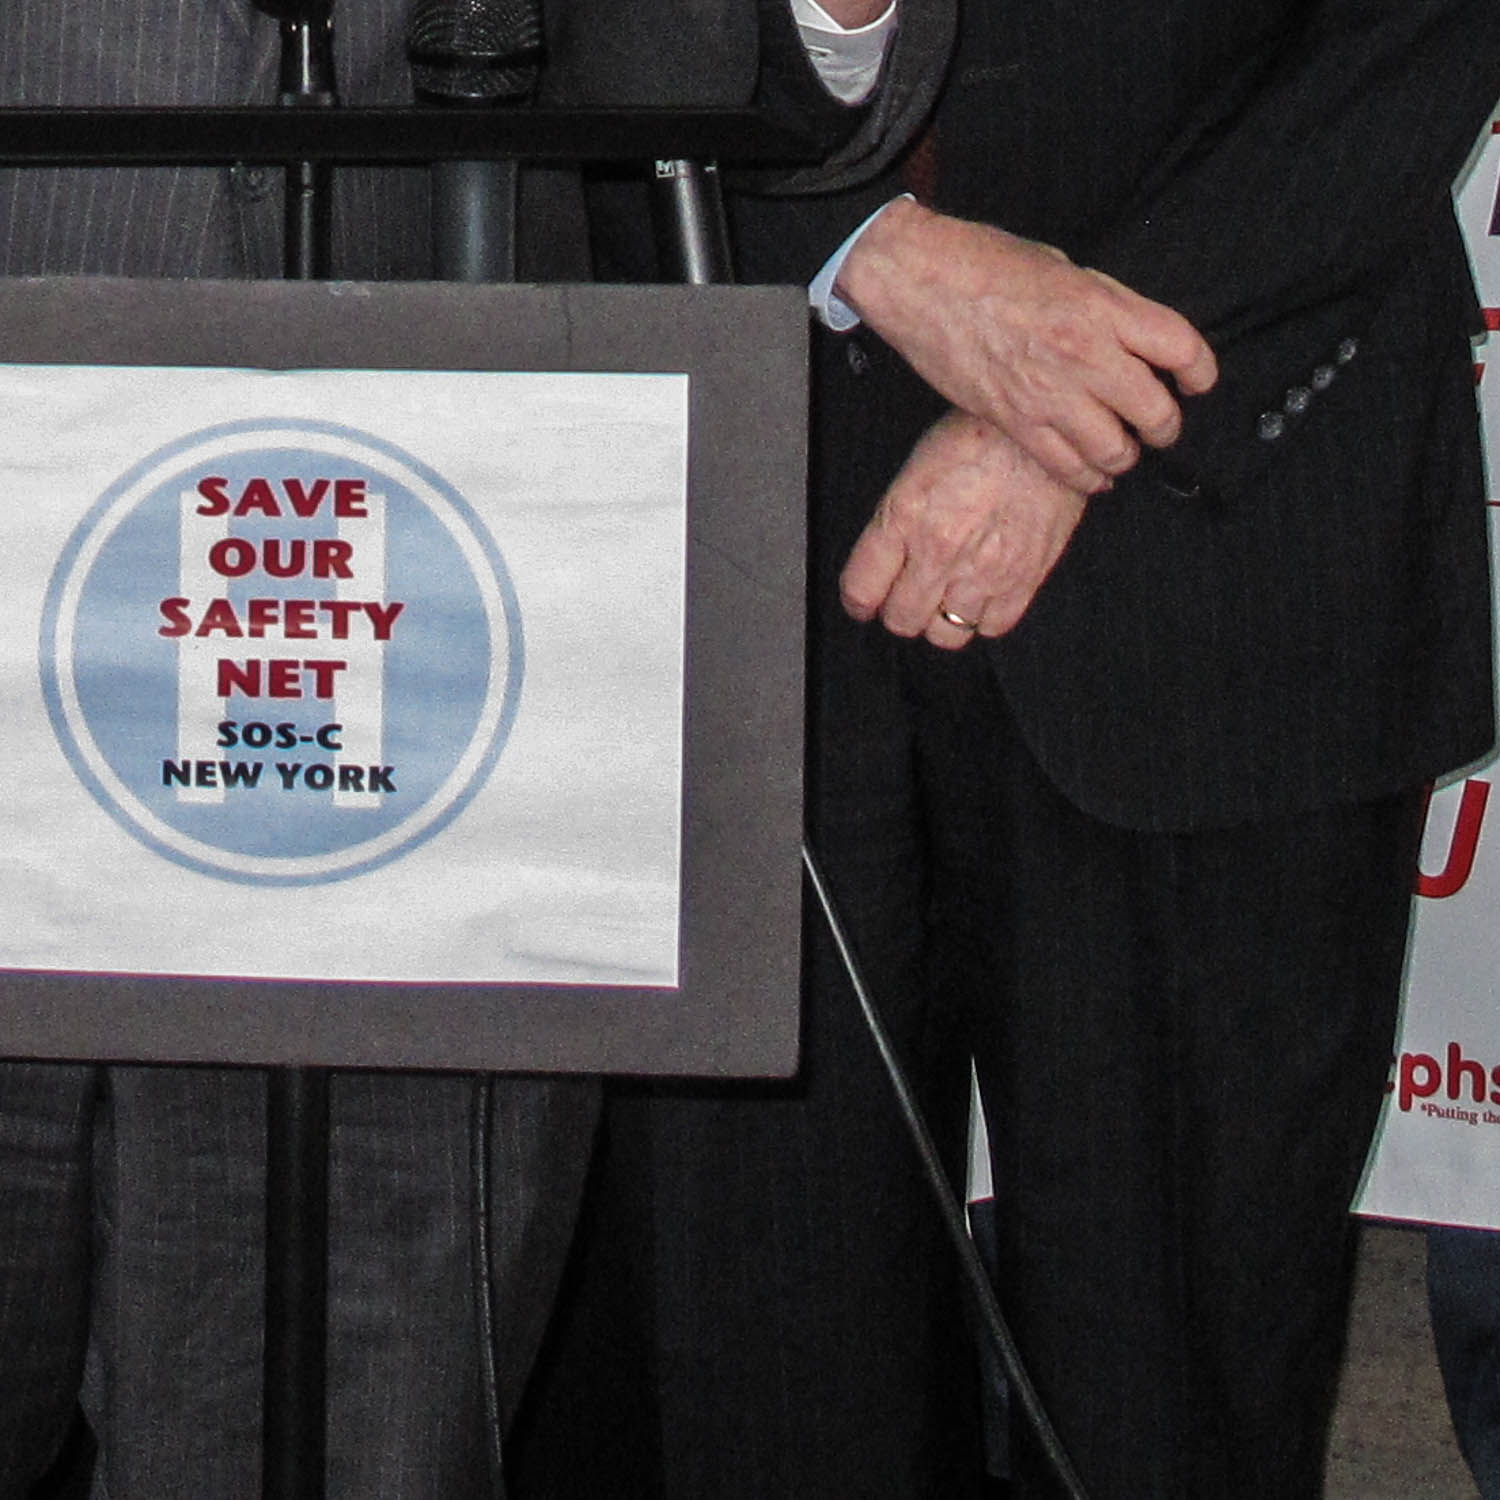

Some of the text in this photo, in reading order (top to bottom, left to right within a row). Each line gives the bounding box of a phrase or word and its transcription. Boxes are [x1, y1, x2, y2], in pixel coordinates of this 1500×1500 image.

[196, 476, 369, 518] SAVE
[208, 538, 354, 580] OUR
[157, 597, 404, 641] SAFETY
[216, 658, 347, 699] NET
[217, 721, 343, 751] SOS-C
[161, 759, 398, 793] NEW YORK
